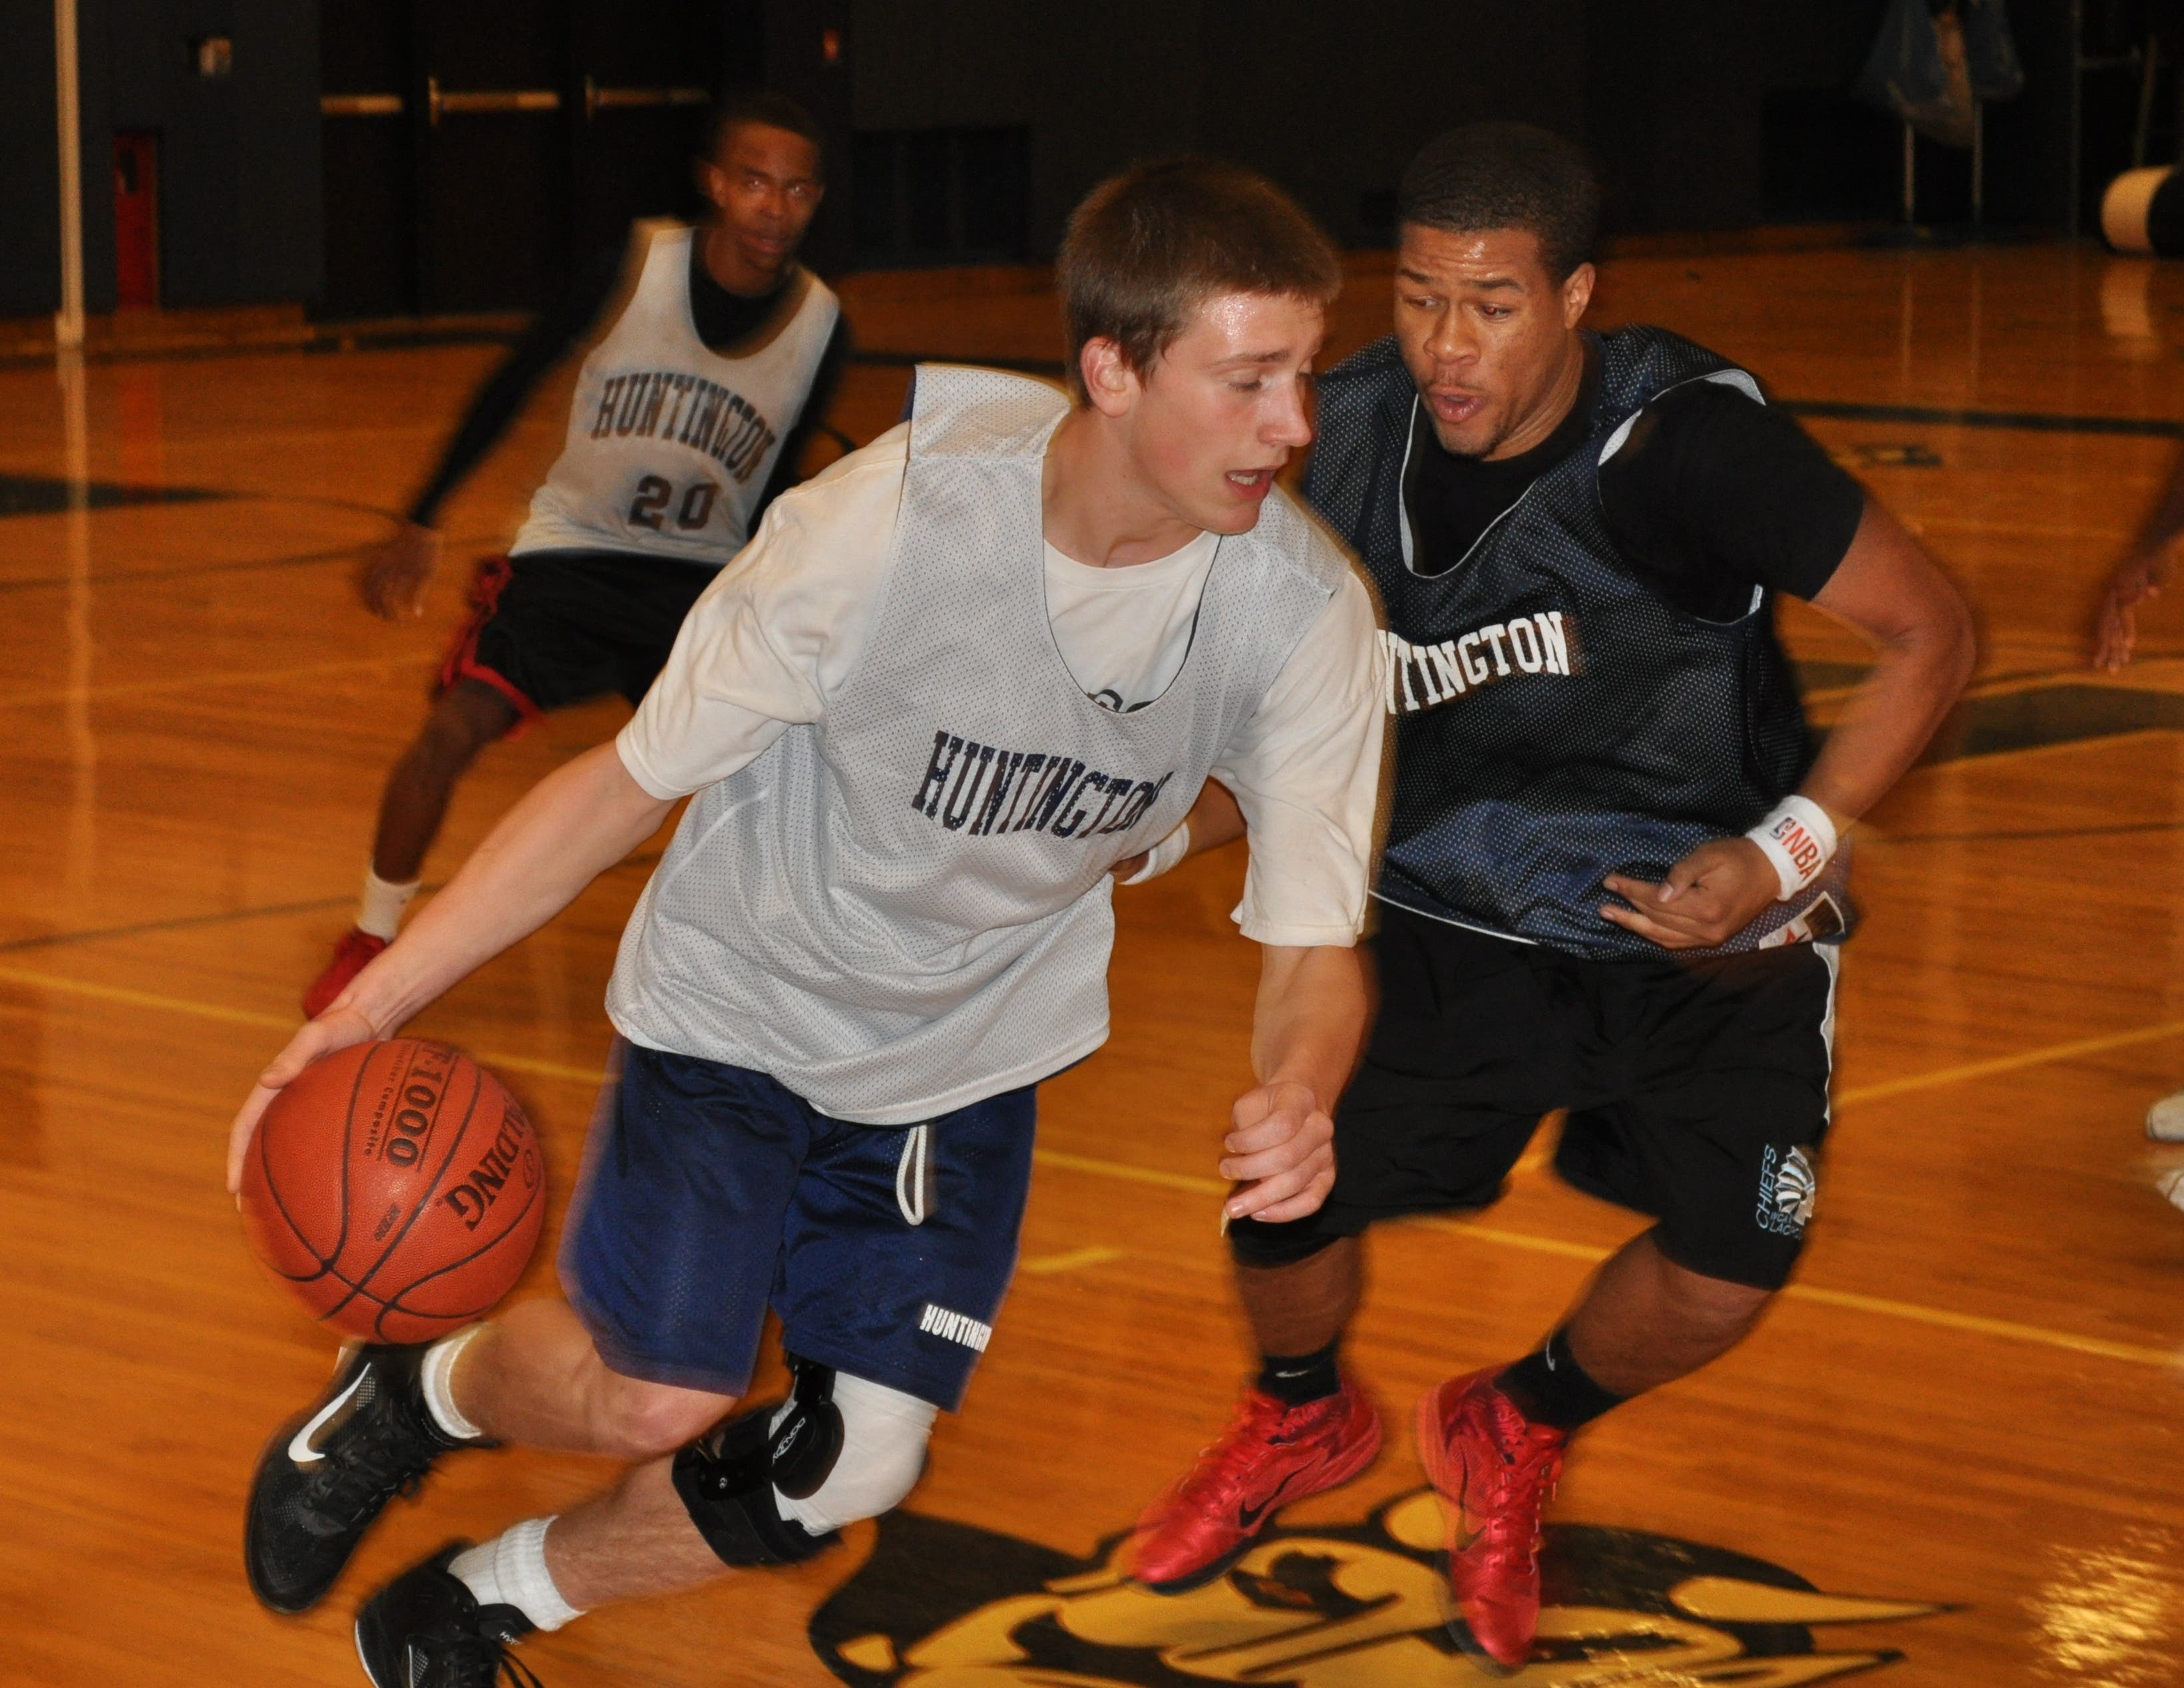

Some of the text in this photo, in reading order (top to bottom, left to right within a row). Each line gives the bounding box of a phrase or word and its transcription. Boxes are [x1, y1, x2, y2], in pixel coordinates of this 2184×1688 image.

[590, 372, 776, 484] HUNTINGTON
[628, 475, 720, 530] 20
[1377, 611, 1570, 714] NTINGTON
[912, 730, 1175, 839] HUNTINGTON
[1782, 827, 1821, 882] NBA
[443, 1104, 526, 1231] ALDING
[1756, 1144, 1777, 1229] CHIEFS
[920, 1304, 992, 1353] HUNTING
